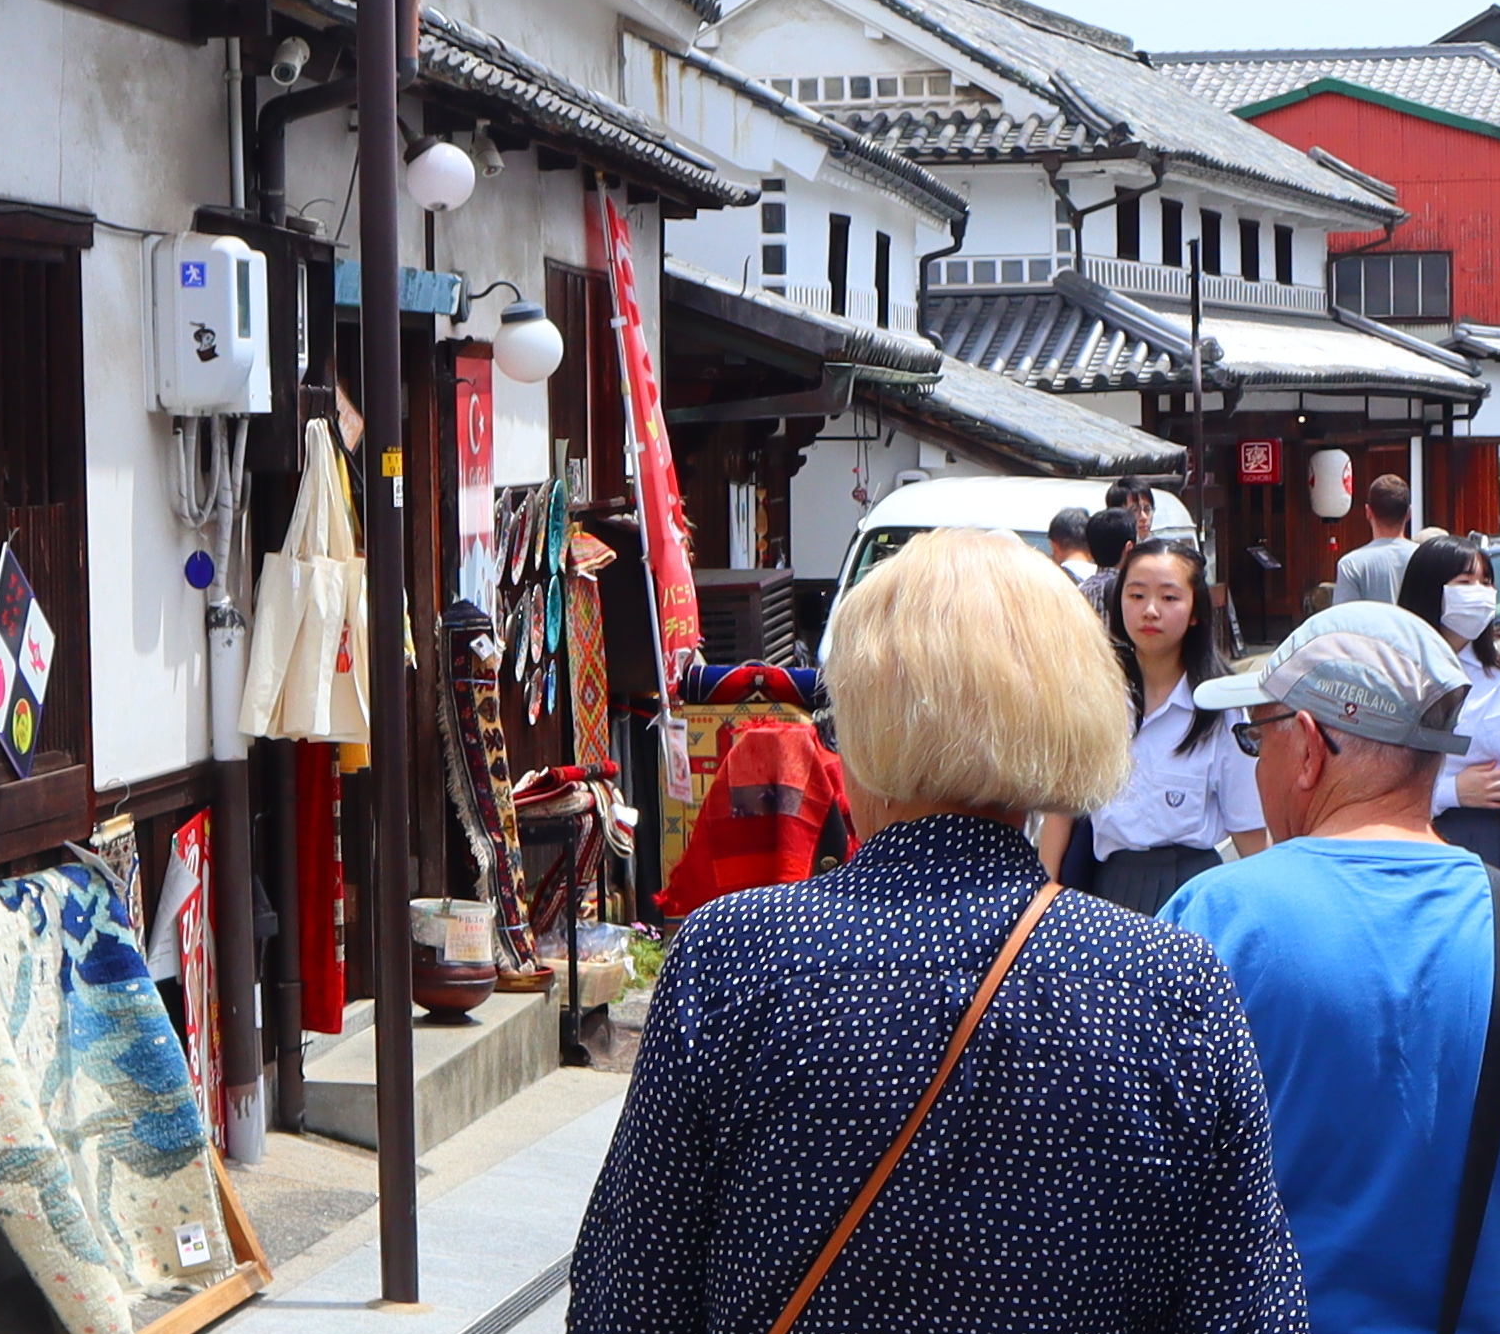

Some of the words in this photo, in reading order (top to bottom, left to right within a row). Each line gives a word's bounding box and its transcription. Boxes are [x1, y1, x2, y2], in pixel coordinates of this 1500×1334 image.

[664, 616, 696, 639] チョコ
[1315, 679, 1397, 714] SWITZERLAND
